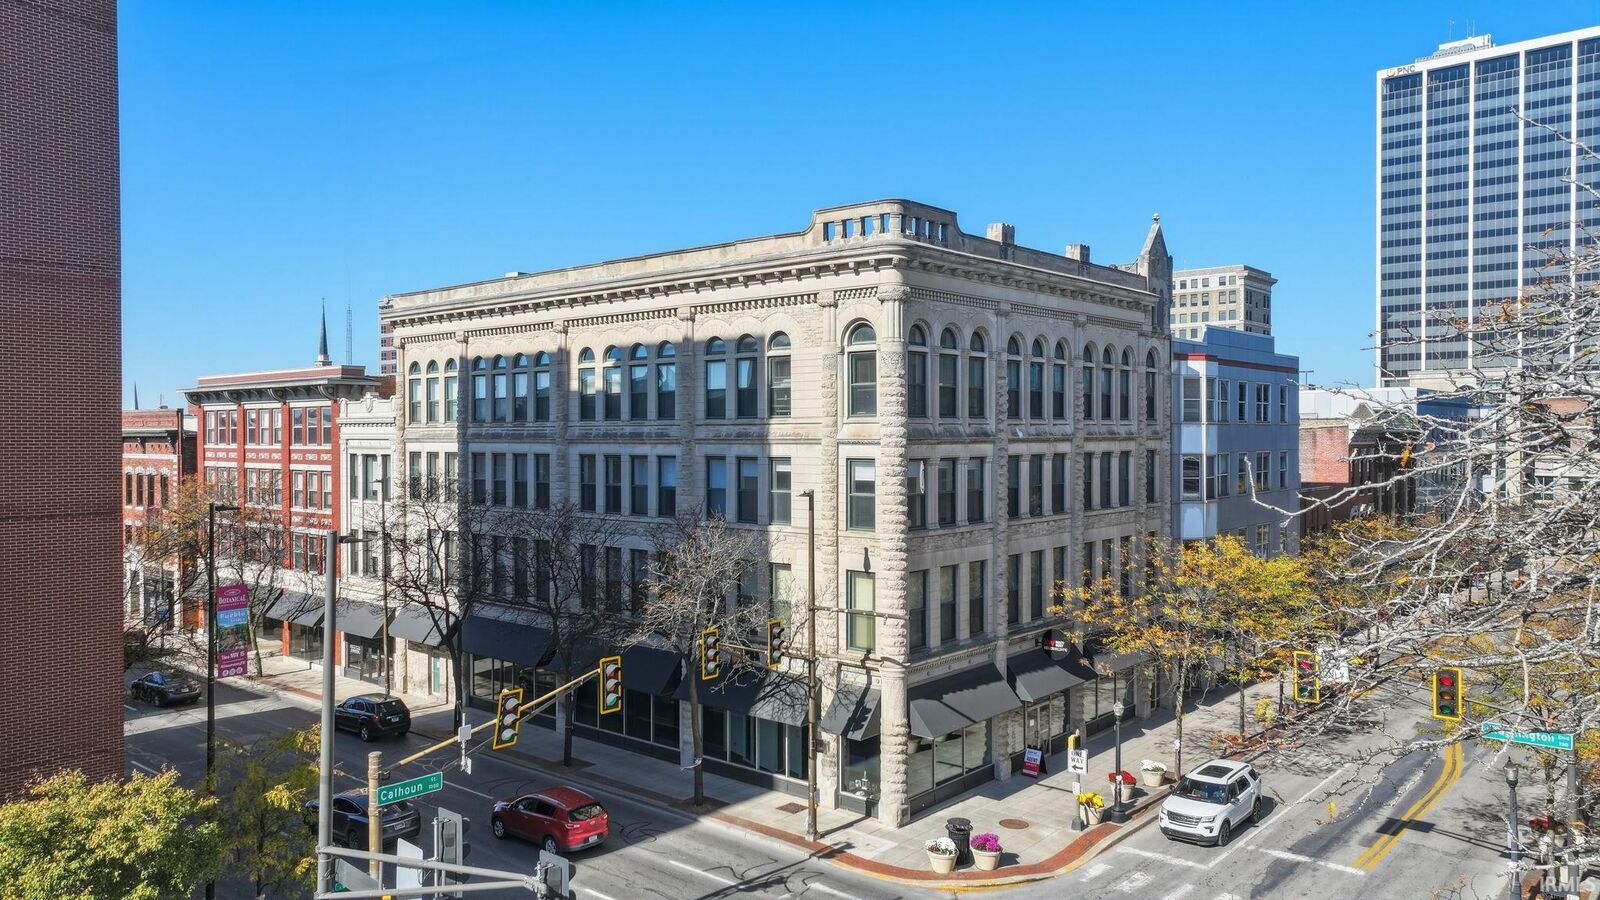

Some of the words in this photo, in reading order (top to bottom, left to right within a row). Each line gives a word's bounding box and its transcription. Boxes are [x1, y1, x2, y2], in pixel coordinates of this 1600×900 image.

[1397, 65, 1415, 74] PNC
[218, 595, 246, 604] BOTANICAL
[1071, 750, 1083, 758] ONE
[381, 783, 422, 800] Calhoun
